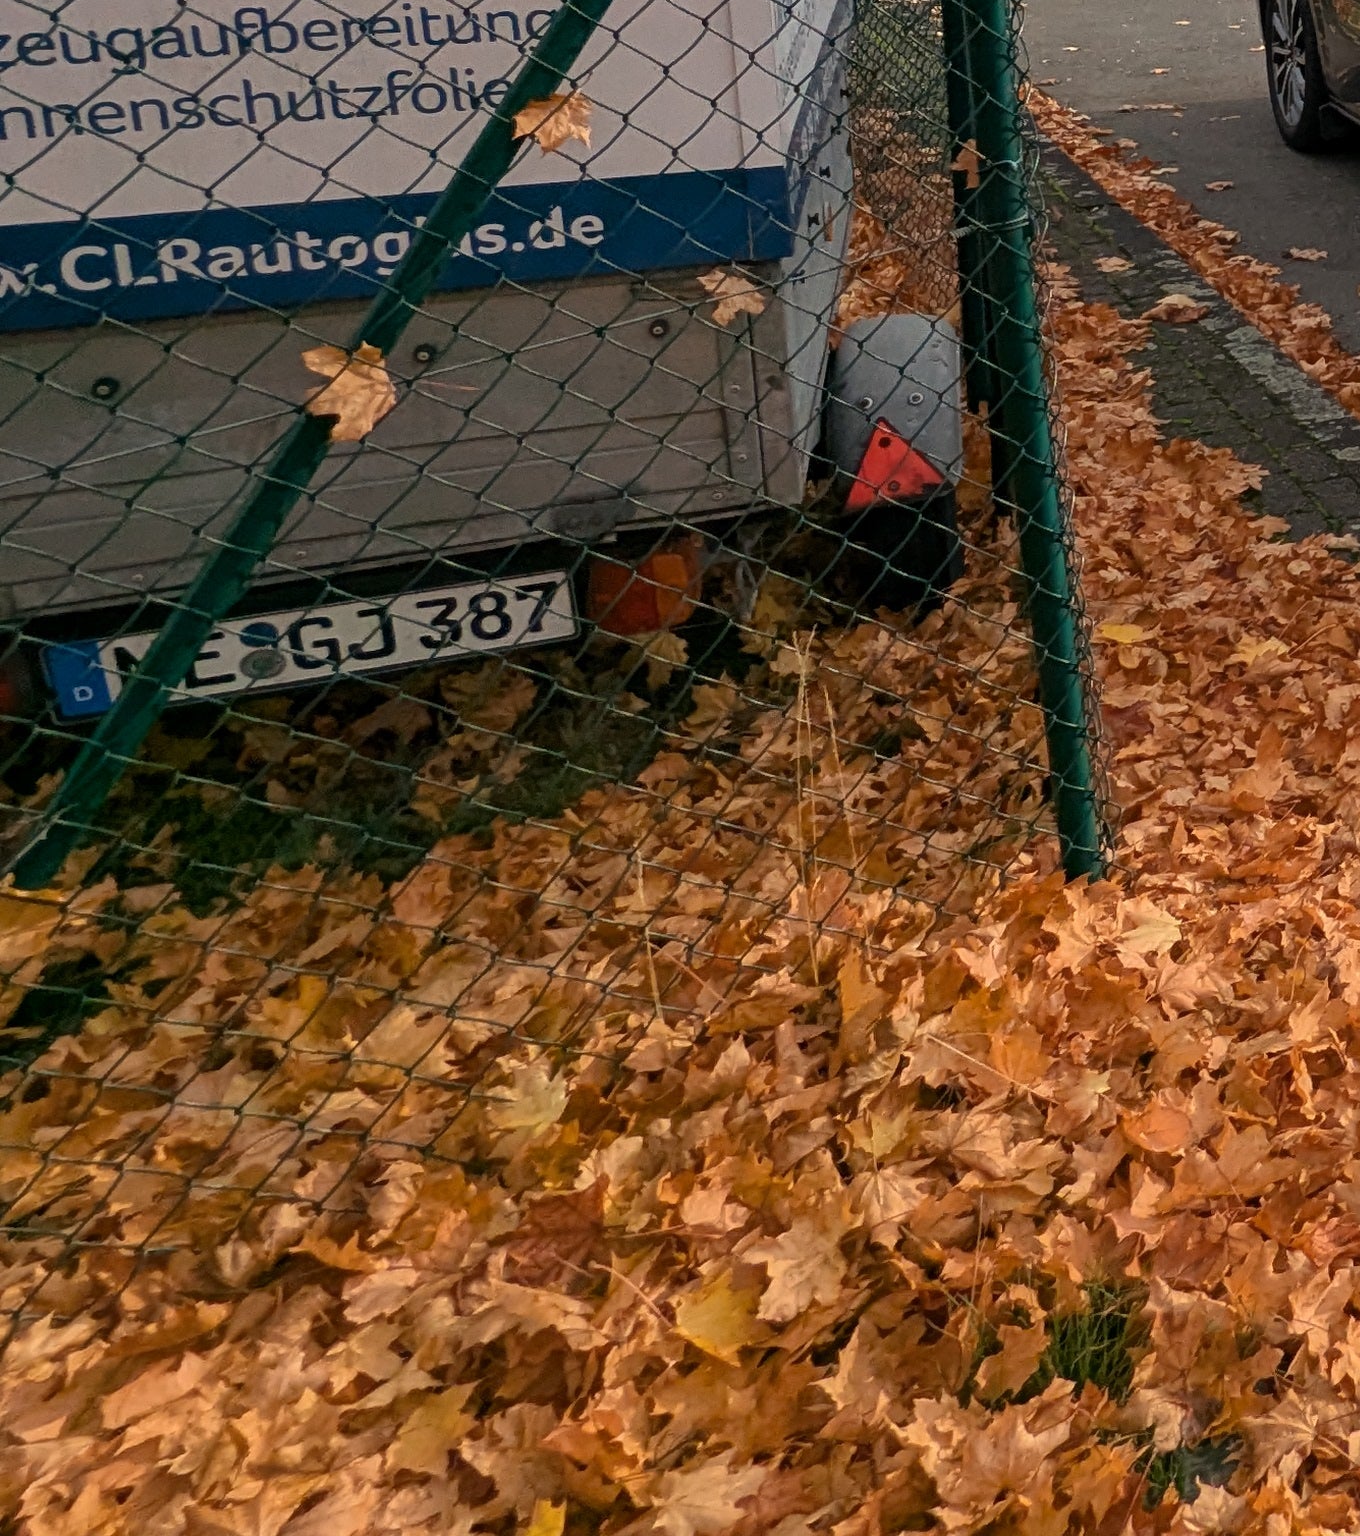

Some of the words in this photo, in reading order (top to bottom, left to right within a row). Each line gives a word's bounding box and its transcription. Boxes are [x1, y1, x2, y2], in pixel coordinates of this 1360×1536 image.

[0, 205, 605, 298] .CLRautogs.de
[73, 685, 94, 703] D
[288, 606, 396, 670] GJ
[416, 581, 560, 650] 387
